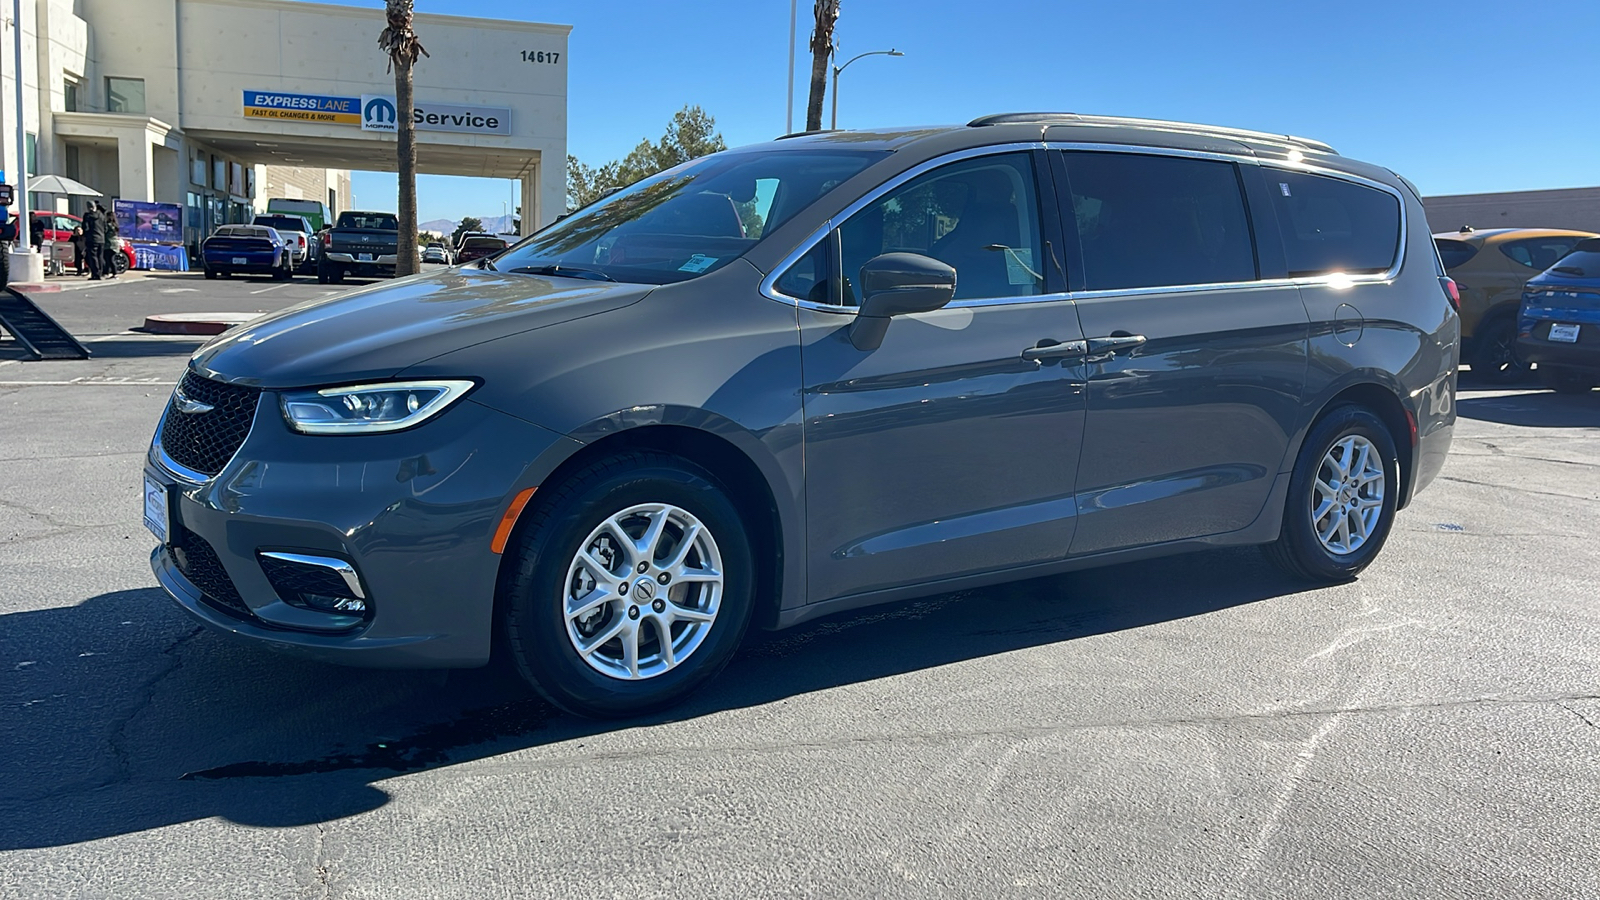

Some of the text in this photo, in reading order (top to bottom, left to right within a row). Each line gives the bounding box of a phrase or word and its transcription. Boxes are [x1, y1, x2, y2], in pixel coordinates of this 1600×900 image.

[520, 50, 560, 64] 14617
[280, 111, 309, 120] CHANGES
[413, 108, 499, 129] Service
